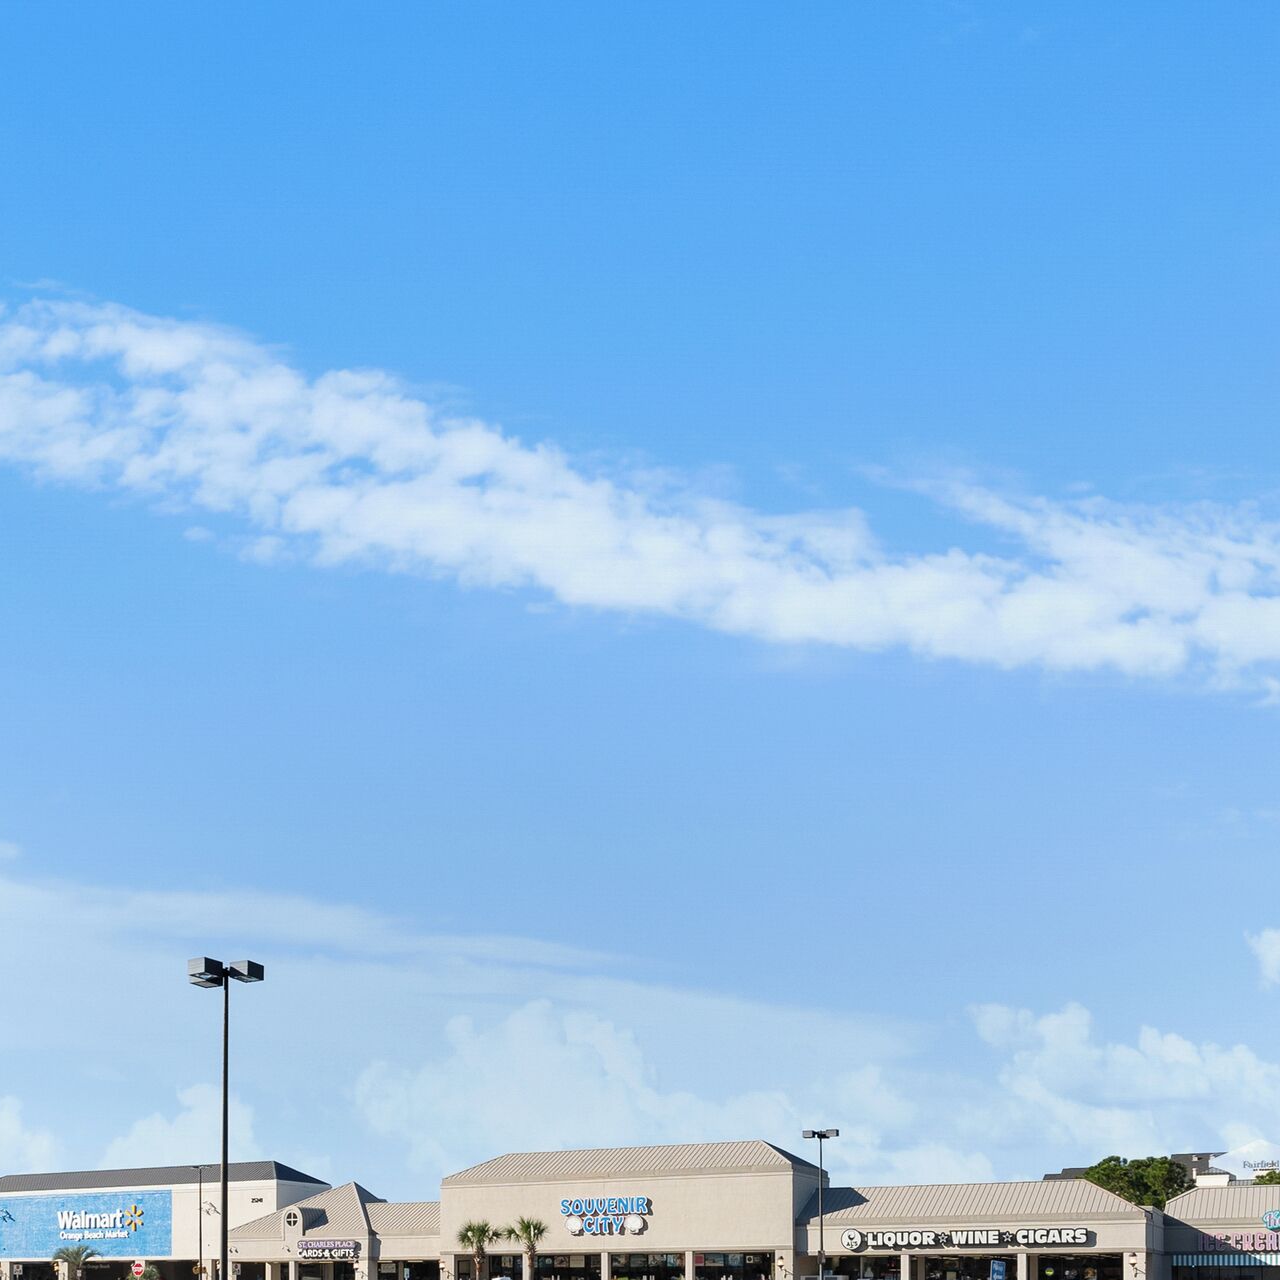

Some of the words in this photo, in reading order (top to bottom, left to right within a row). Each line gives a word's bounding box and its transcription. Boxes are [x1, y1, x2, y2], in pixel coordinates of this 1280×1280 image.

[1243, 1160, 1280, 1169] Fairfield
[560, 1197, 648, 1215] SOUVENIR
[57, 1209, 123, 1229] Walmart
[582, 1215, 625, 1233] CITY
[60, 1231, 82, 1241] Orange
[84, 1230, 104, 1239] Beach
[105, 1229, 129, 1239] Market
[307, 1240, 334, 1248] CHARLES
[335, 1240, 356, 1248] PLACE
[867, 1231, 936, 1246] LIQUOR
[950, 1230, 1000, 1244] WINE
[1016, 1228, 1088, 1244] CIGARS
[1198, 1232, 1225, 1250] ICE
[297, 1249, 323, 1258] CARDS
[323, 1249, 330, 1257] &
[331, 1249, 354, 1257] GIFTS
